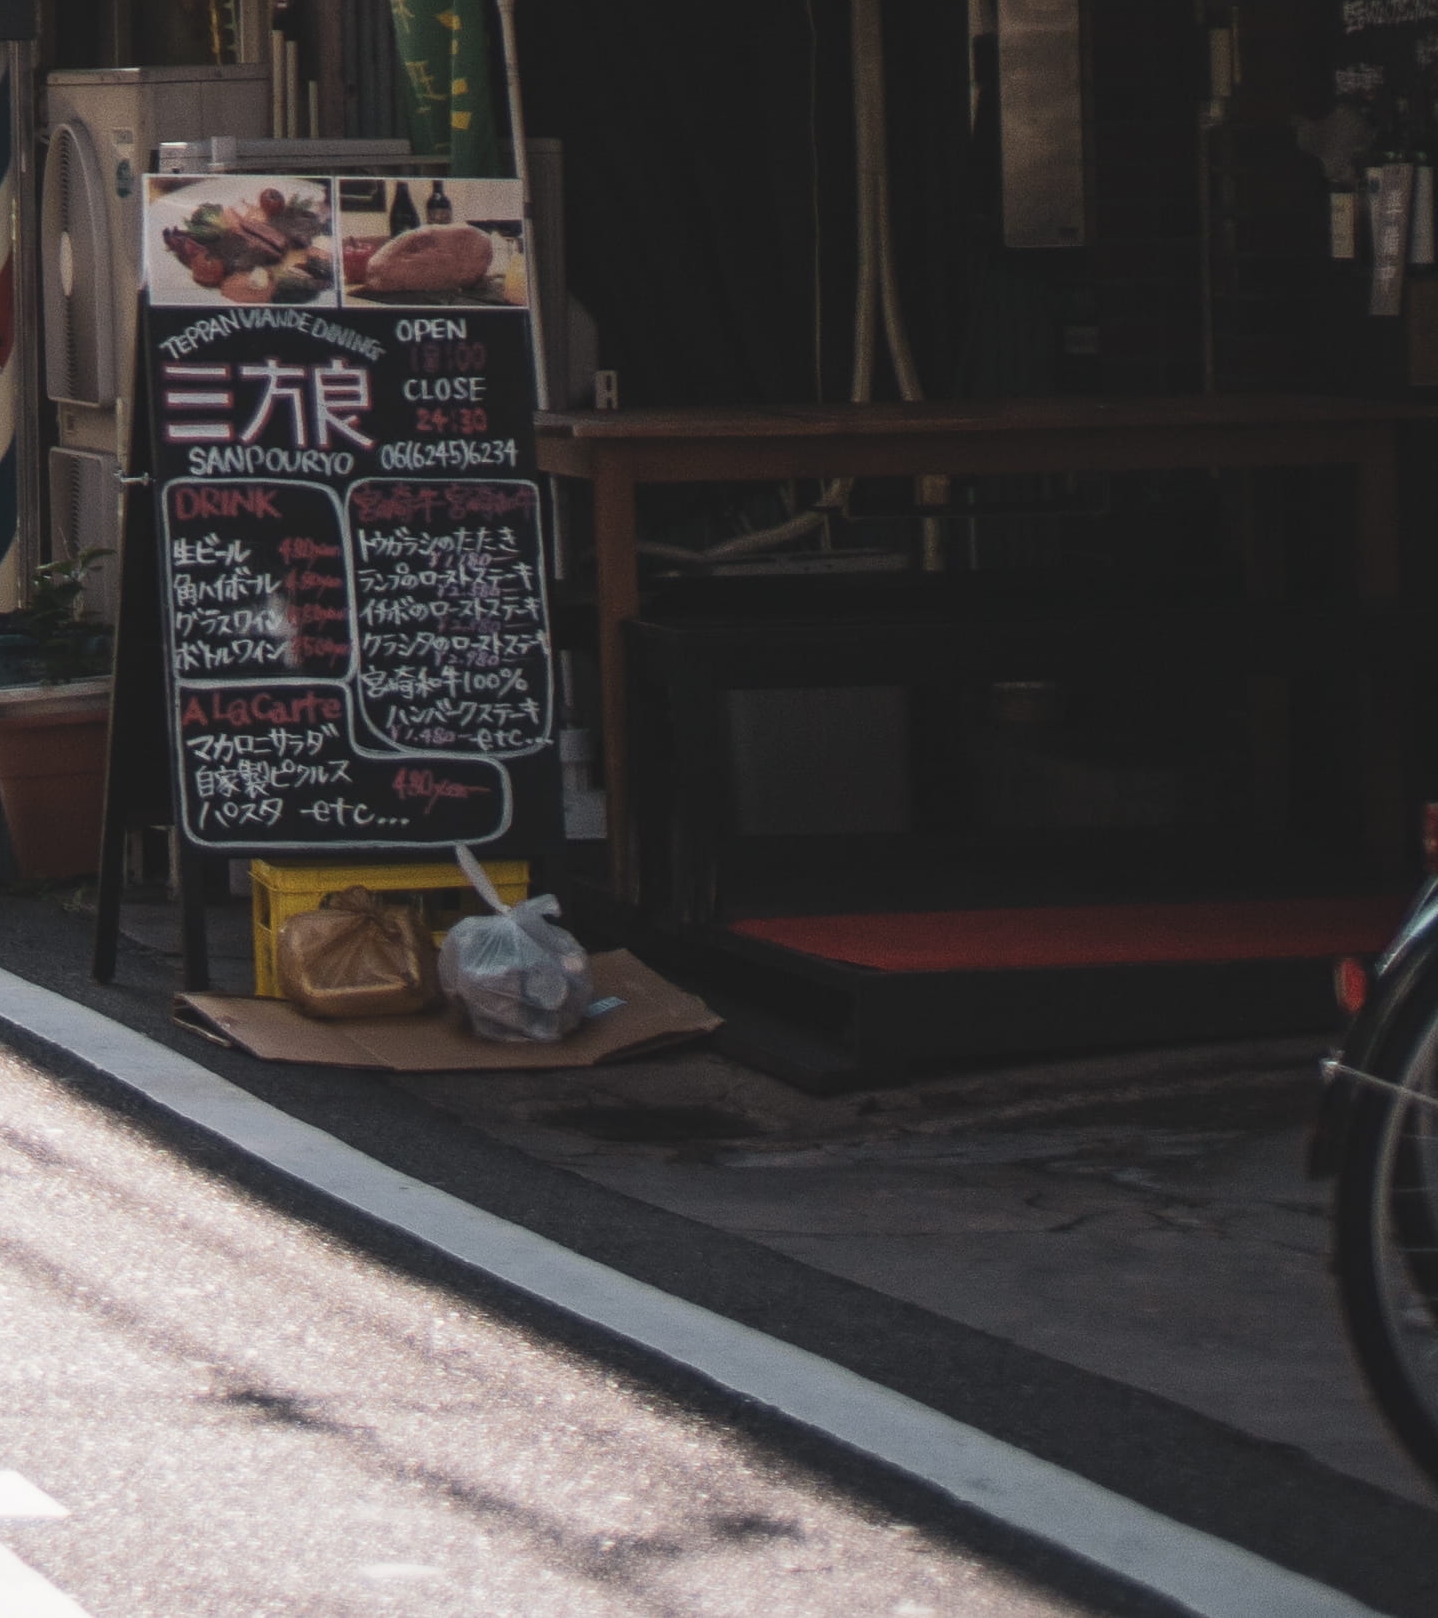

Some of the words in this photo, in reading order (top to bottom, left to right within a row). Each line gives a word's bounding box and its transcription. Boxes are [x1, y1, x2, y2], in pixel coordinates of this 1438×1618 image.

[395, 317, 468, 342] OPEN
[163, 357, 376, 449] 三方良
[403, 377, 487, 402] CLOSE
[187, 446, 355, 477] SANPOURYO
[380, 439, 519, 470] 06(6245)6234
[175, 485, 285, 522] DRINK
[173, 532, 252, 567] 生ビール
[173, 566, 284, 607] 角ハイボール
[174, 638, 290, 671] ボトルワイン
[186, 721, 341, 763] マカロニサラダ
[194, 758, 354, 799] 自家製ピクルス
[198, 797, 285, 830] パスタ
